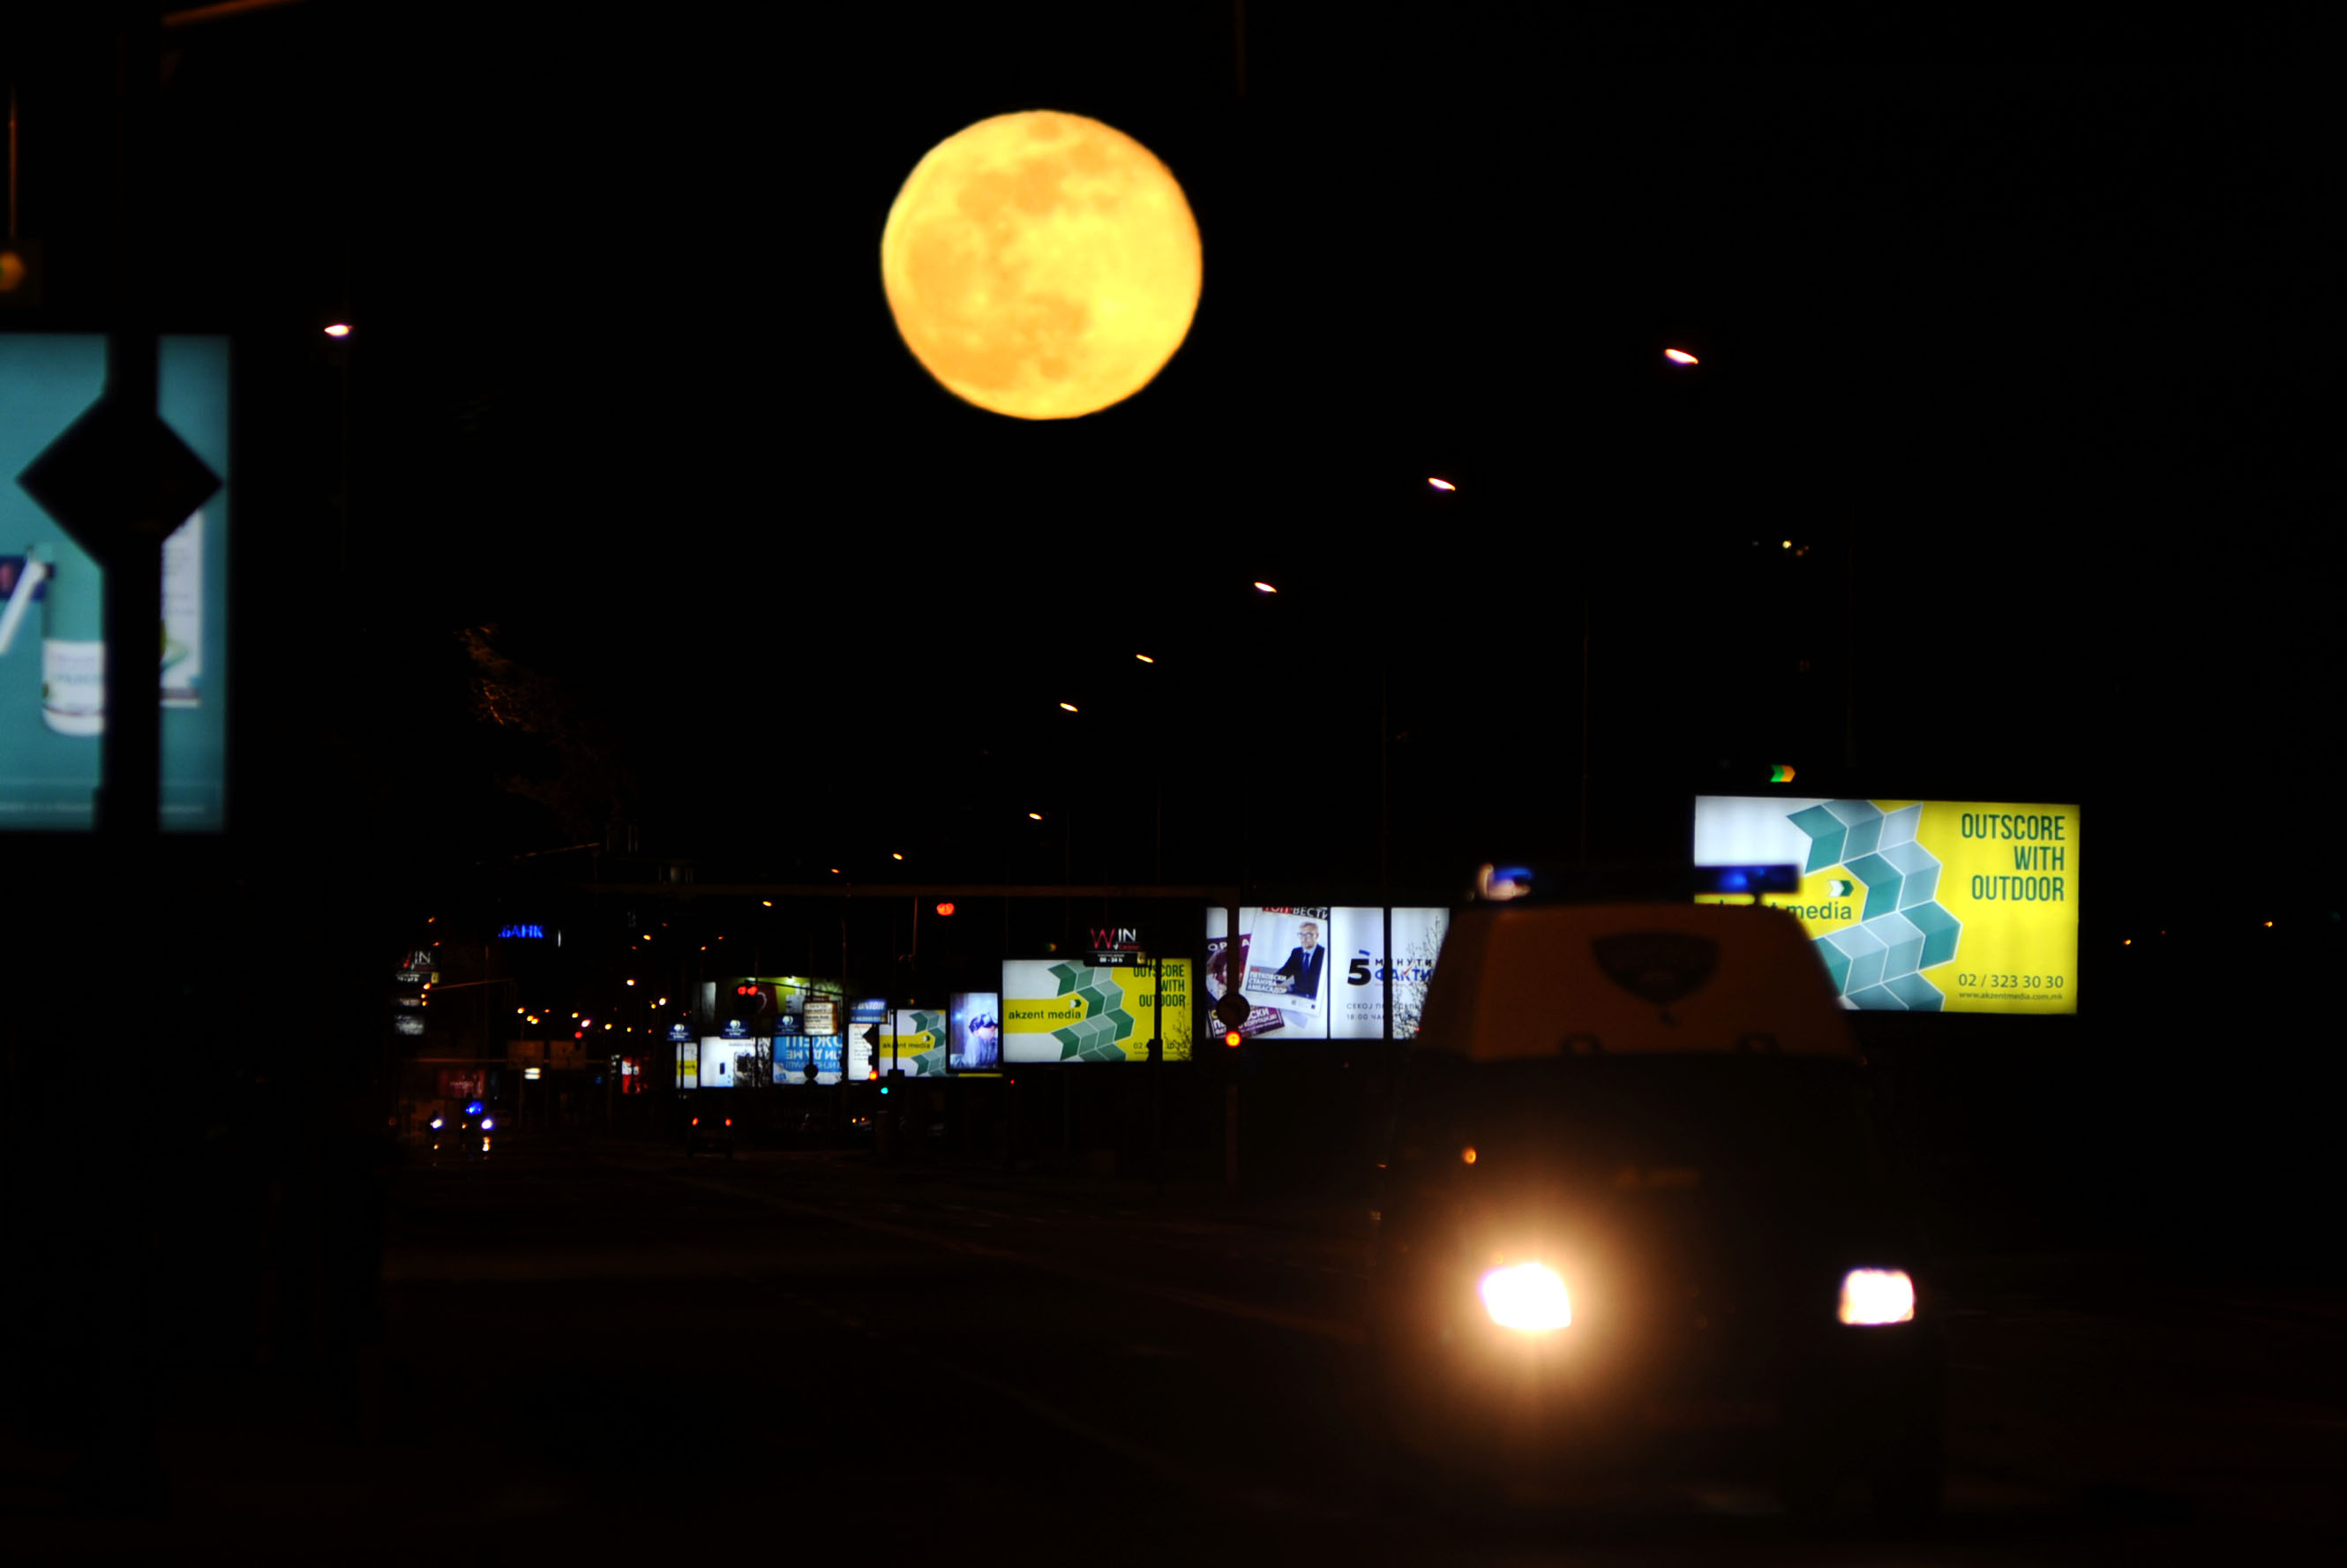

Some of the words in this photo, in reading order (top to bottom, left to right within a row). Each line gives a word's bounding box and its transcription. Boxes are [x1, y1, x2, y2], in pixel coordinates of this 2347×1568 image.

[1961, 813, 2066, 841] OUTSCORE
[2013, 845, 2065, 871] WITH
[1971, 874, 2065, 902] OUTDOOR
[1347, 957, 1371, 986] 5
[1375, 958, 1432, 968] МНУТИ
[1958, 972, 1976, 988] 02
[1990, 973, 2018, 989] 323
[2022, 974, 2043, 989] 30
[2045, 974, 2065, 990] 30
[1958, 991, 2063, 1002] www.akzentmedia.com.mk
[1009, 1009, 1045, 1019] akzent
[1048, 1009, 1082, 1019] media
